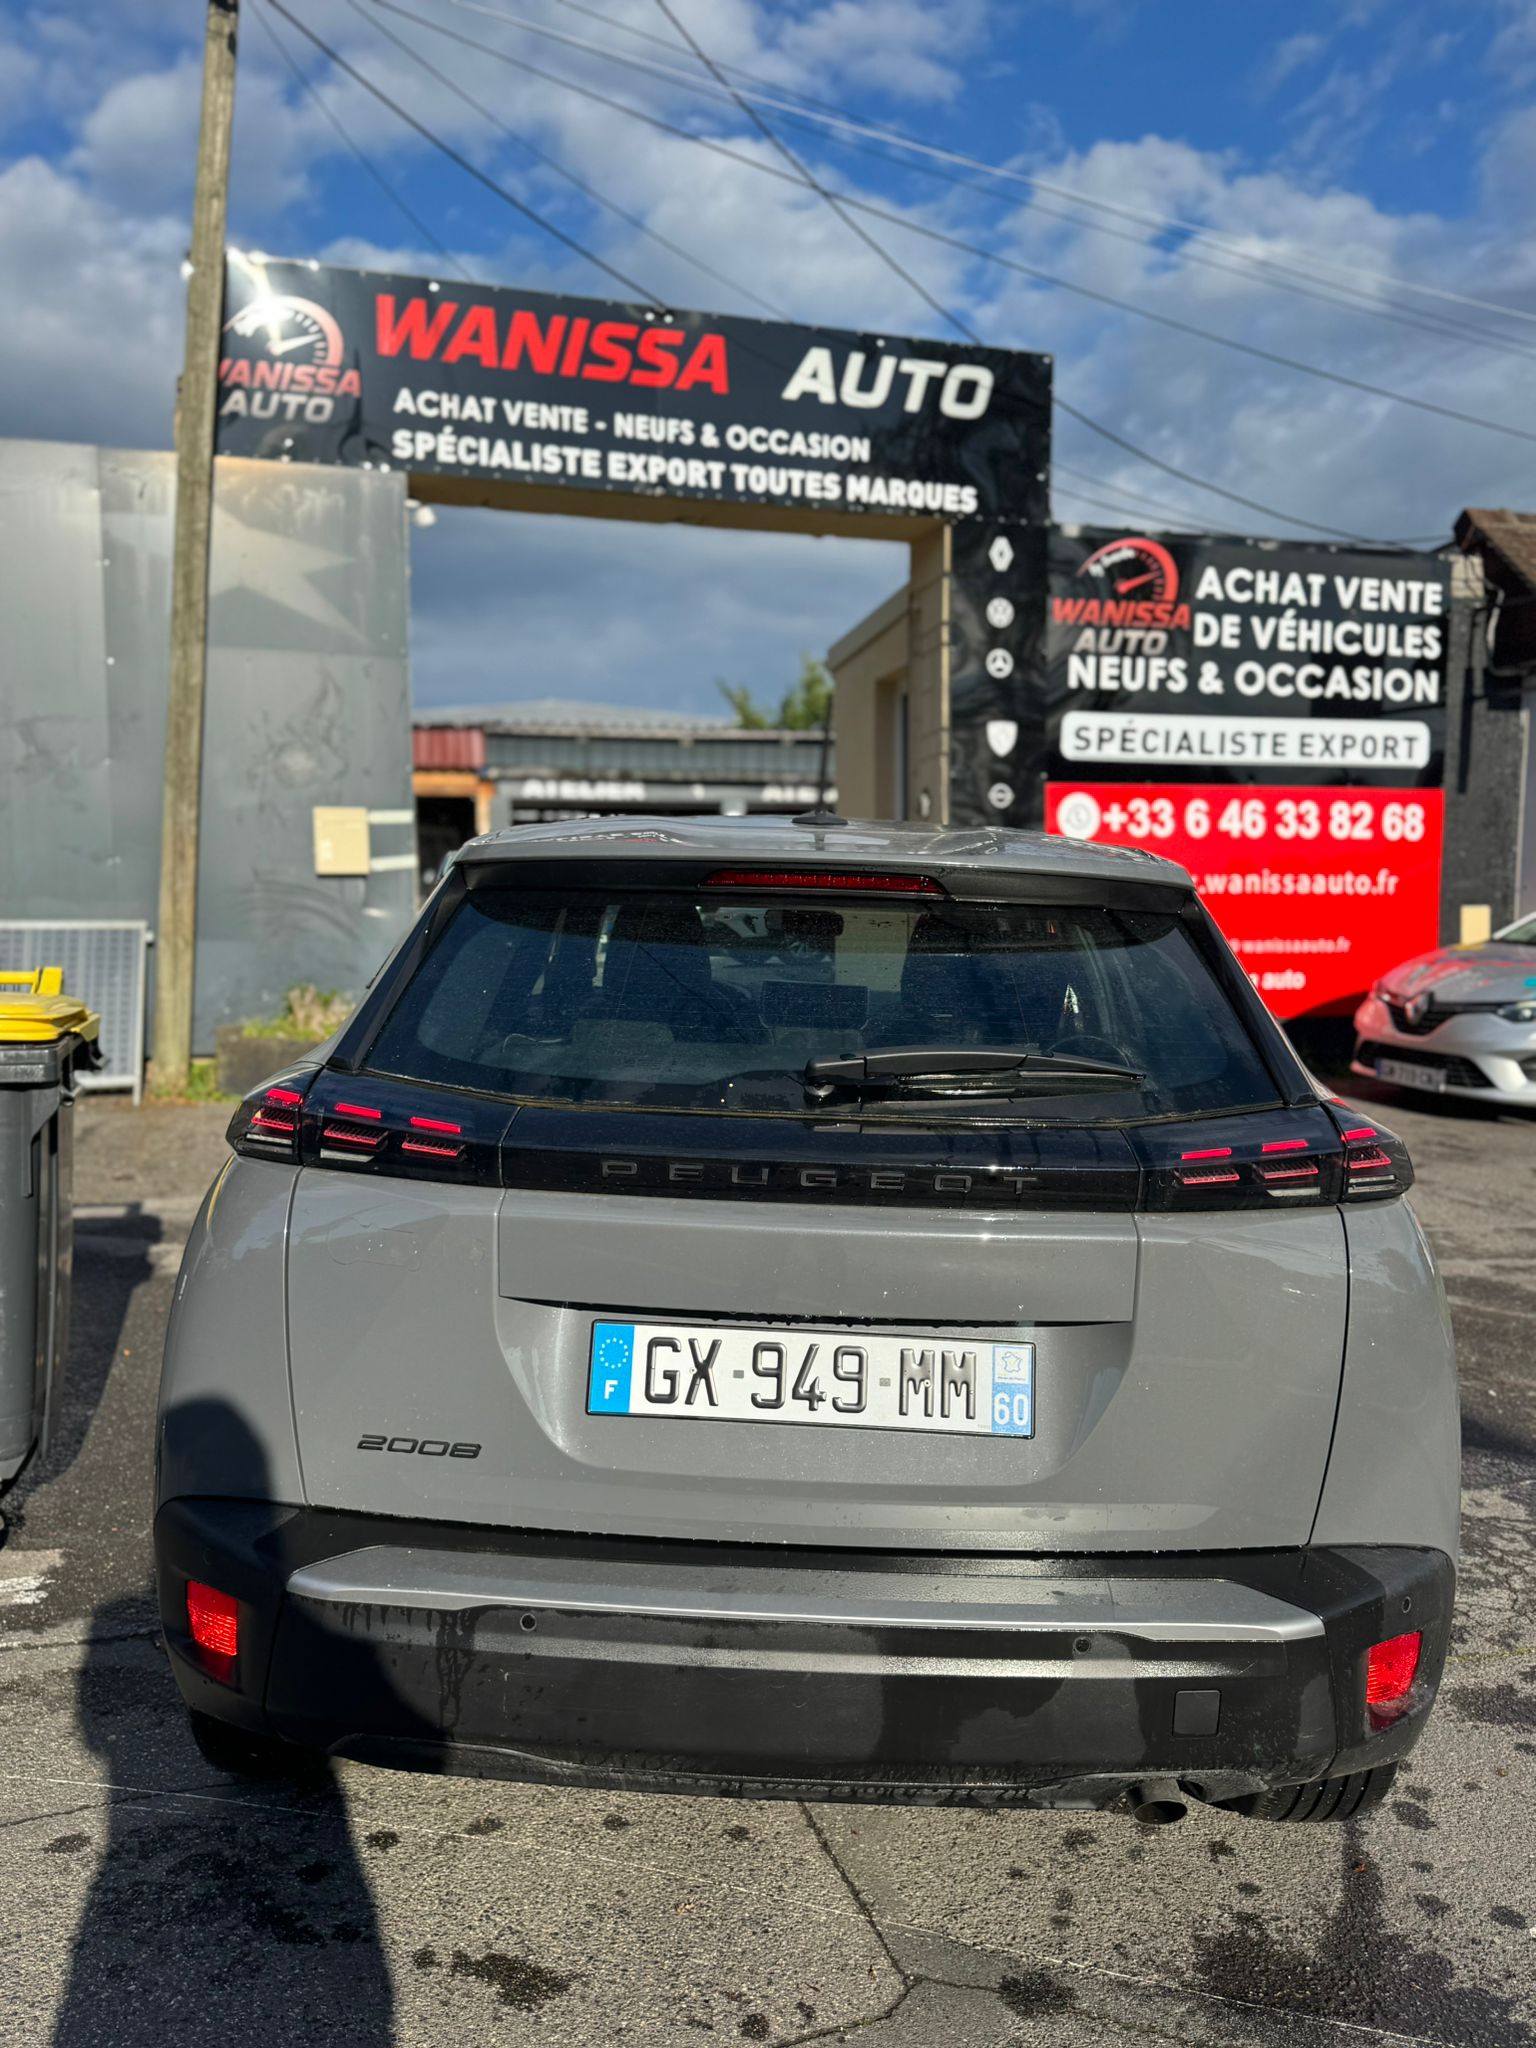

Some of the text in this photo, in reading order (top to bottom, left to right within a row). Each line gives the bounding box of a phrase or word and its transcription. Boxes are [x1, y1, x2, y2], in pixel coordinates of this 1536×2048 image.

[375, 294, 994, 420] WANISSA AUTO
[220, 389, 334, 424] AUTO
[393, 387, 496, 425] ACHAT
[502, 400, 589, 434] VENTE
[614, 412, 695, 447] NEUFS
[701, 423, 720, 447] &
[726, 425, 870, 462] OCCASION
[391, 426, 978, 513] SPÉCIALISTE EXPORT TOUTES MARQUES
[1195, 566, 1442, 615] ACHAT VENTE
[1052, 597, 1191, 631] WANISSA
[1194, 609, 1442, 660] DE VÉHICULES
[1072, 627, 1168, 656] AUTO
[1067, 655, 1439, 702] NEUFS & OCCASION
[1074, 718, 1418, 759] SPÉCIALISTE EXPORT
[1102, 797, 1425, 842] +33 6 46 33 82 68
[1262, 969, 1305, 990] auto
[603, 1162, 1037, 1194] PEUGEOT
[603, 1379, 618, 1399] F
[994, 1391, 1029, 1426] 60
[357, 1434, 482, 1459] 2008
